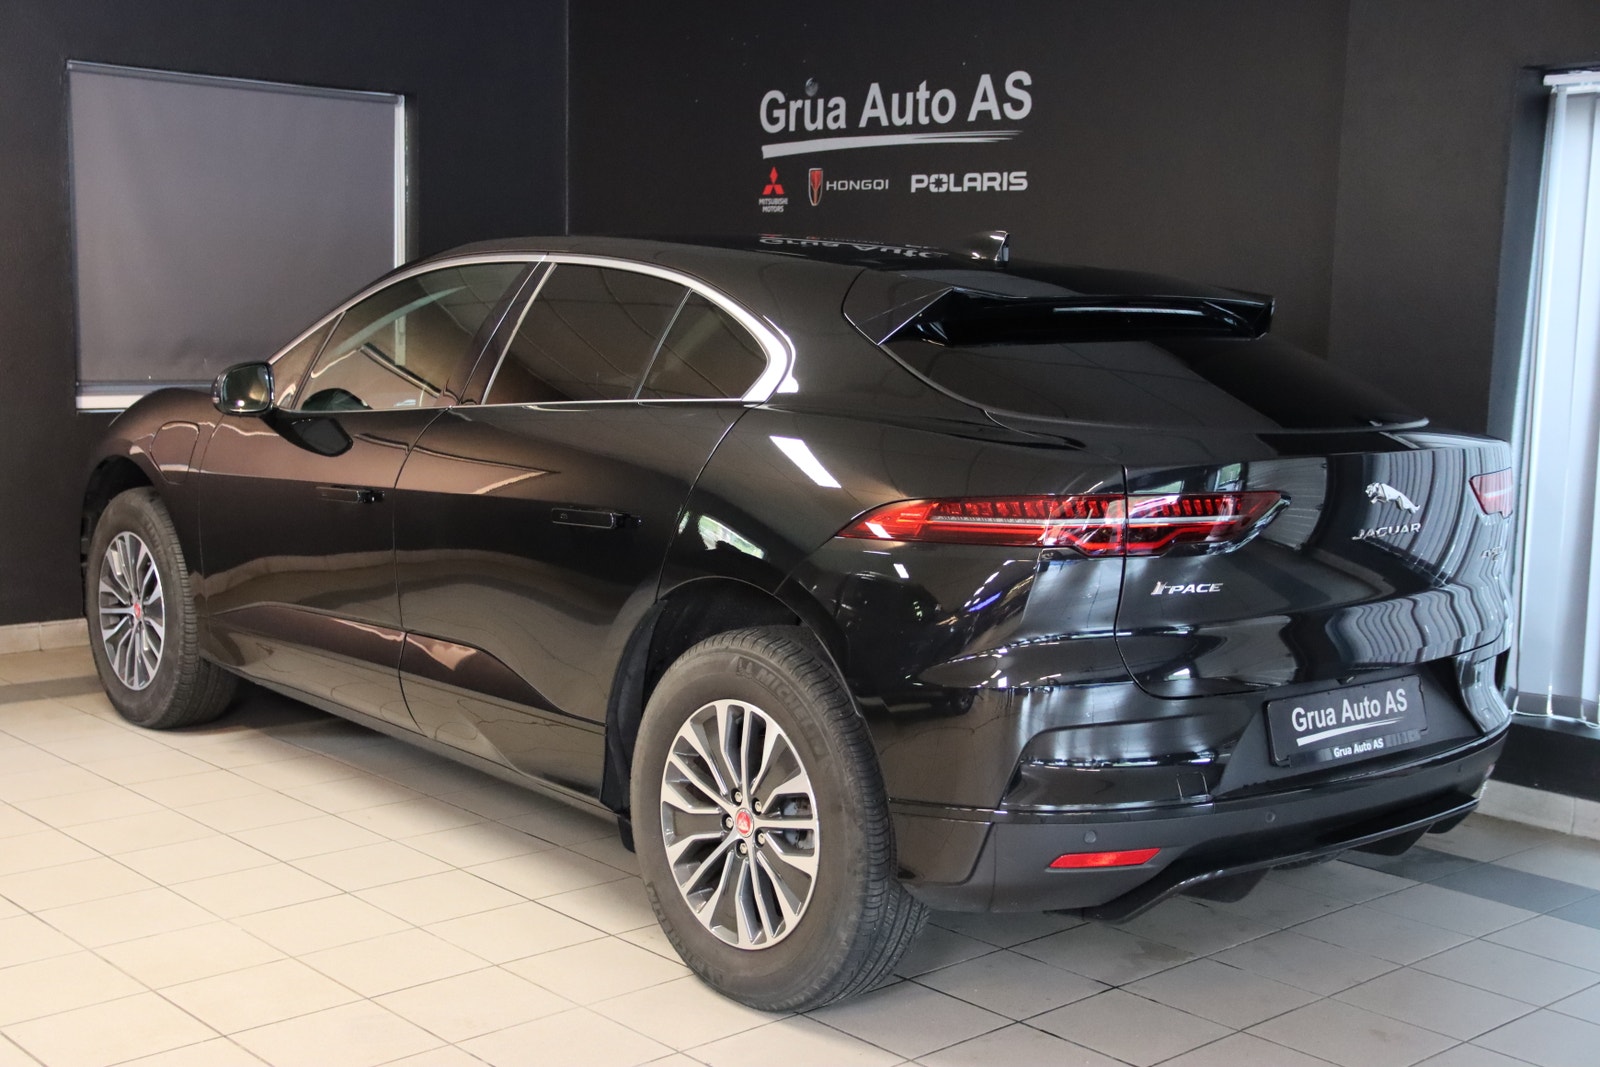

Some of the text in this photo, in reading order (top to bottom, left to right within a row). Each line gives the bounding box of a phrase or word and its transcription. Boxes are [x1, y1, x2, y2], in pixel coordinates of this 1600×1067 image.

[759, 70, 1033, 133] Grua Auto AS
[826, 179, 889, 191] HONGQI
[910, 171, 1029, 193] POLARIS
[759, 198, 789, 206] MITSUBISHI
[762, 205, 785, 213] MOTORS
[1351, 522, 1421, 540] JAGUAR
[1291, 688, 1408, 732] Grua Auto AS
[1333, 738, 1385, 758] Grua Auto AS
